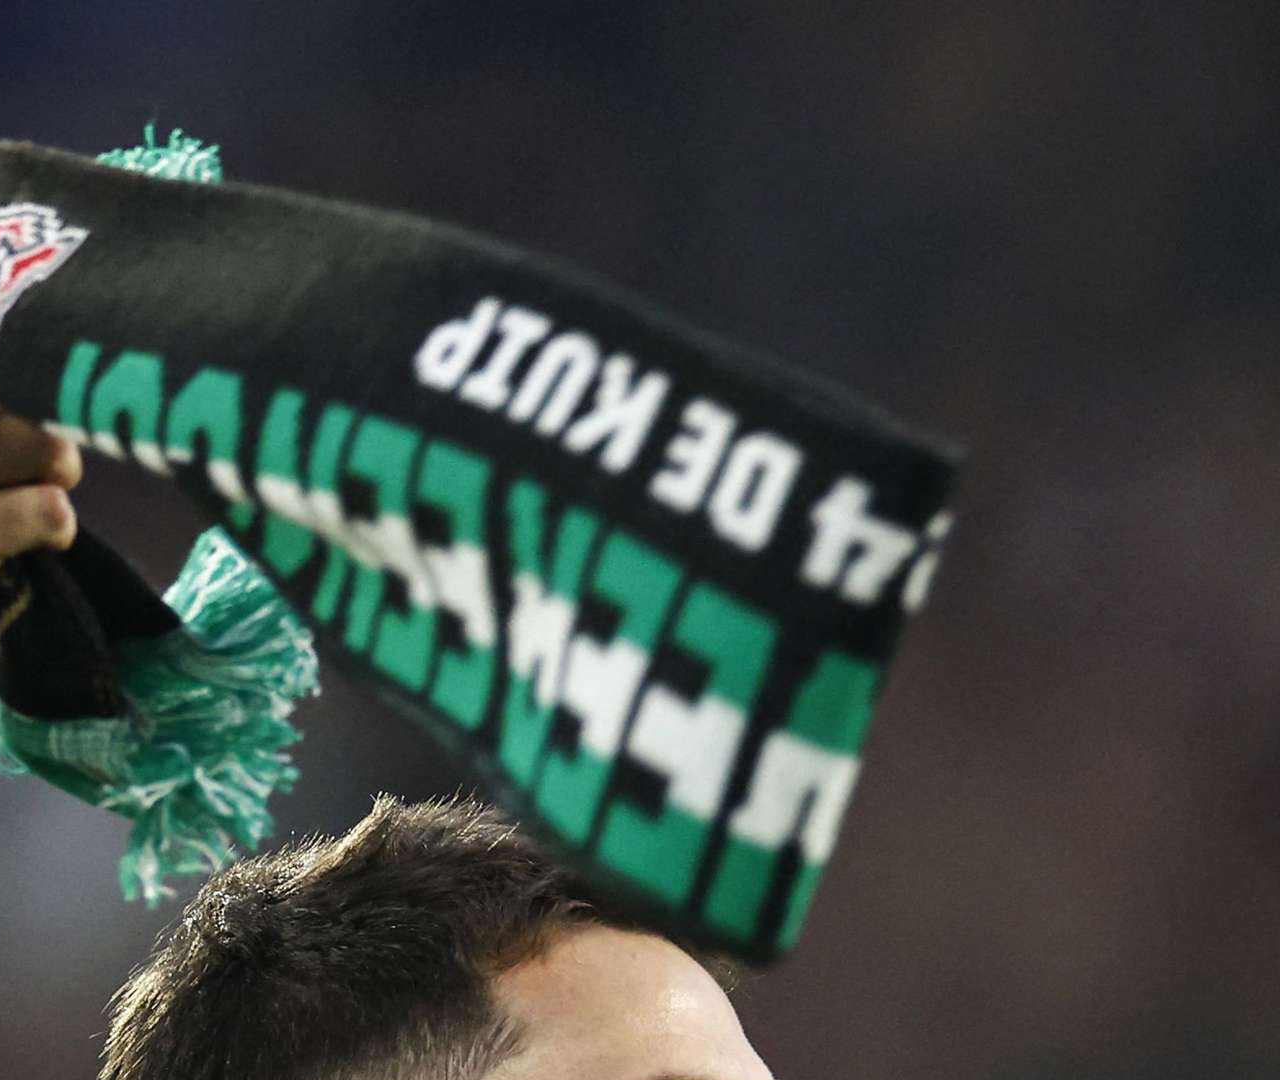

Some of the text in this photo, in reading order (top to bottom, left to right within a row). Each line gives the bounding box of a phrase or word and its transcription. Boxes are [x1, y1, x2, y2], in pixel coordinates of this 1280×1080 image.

[412, 295, 673, 474] KUIP
[647, 394, 807, 554] DE
[800, 474, 956, 614] 4
